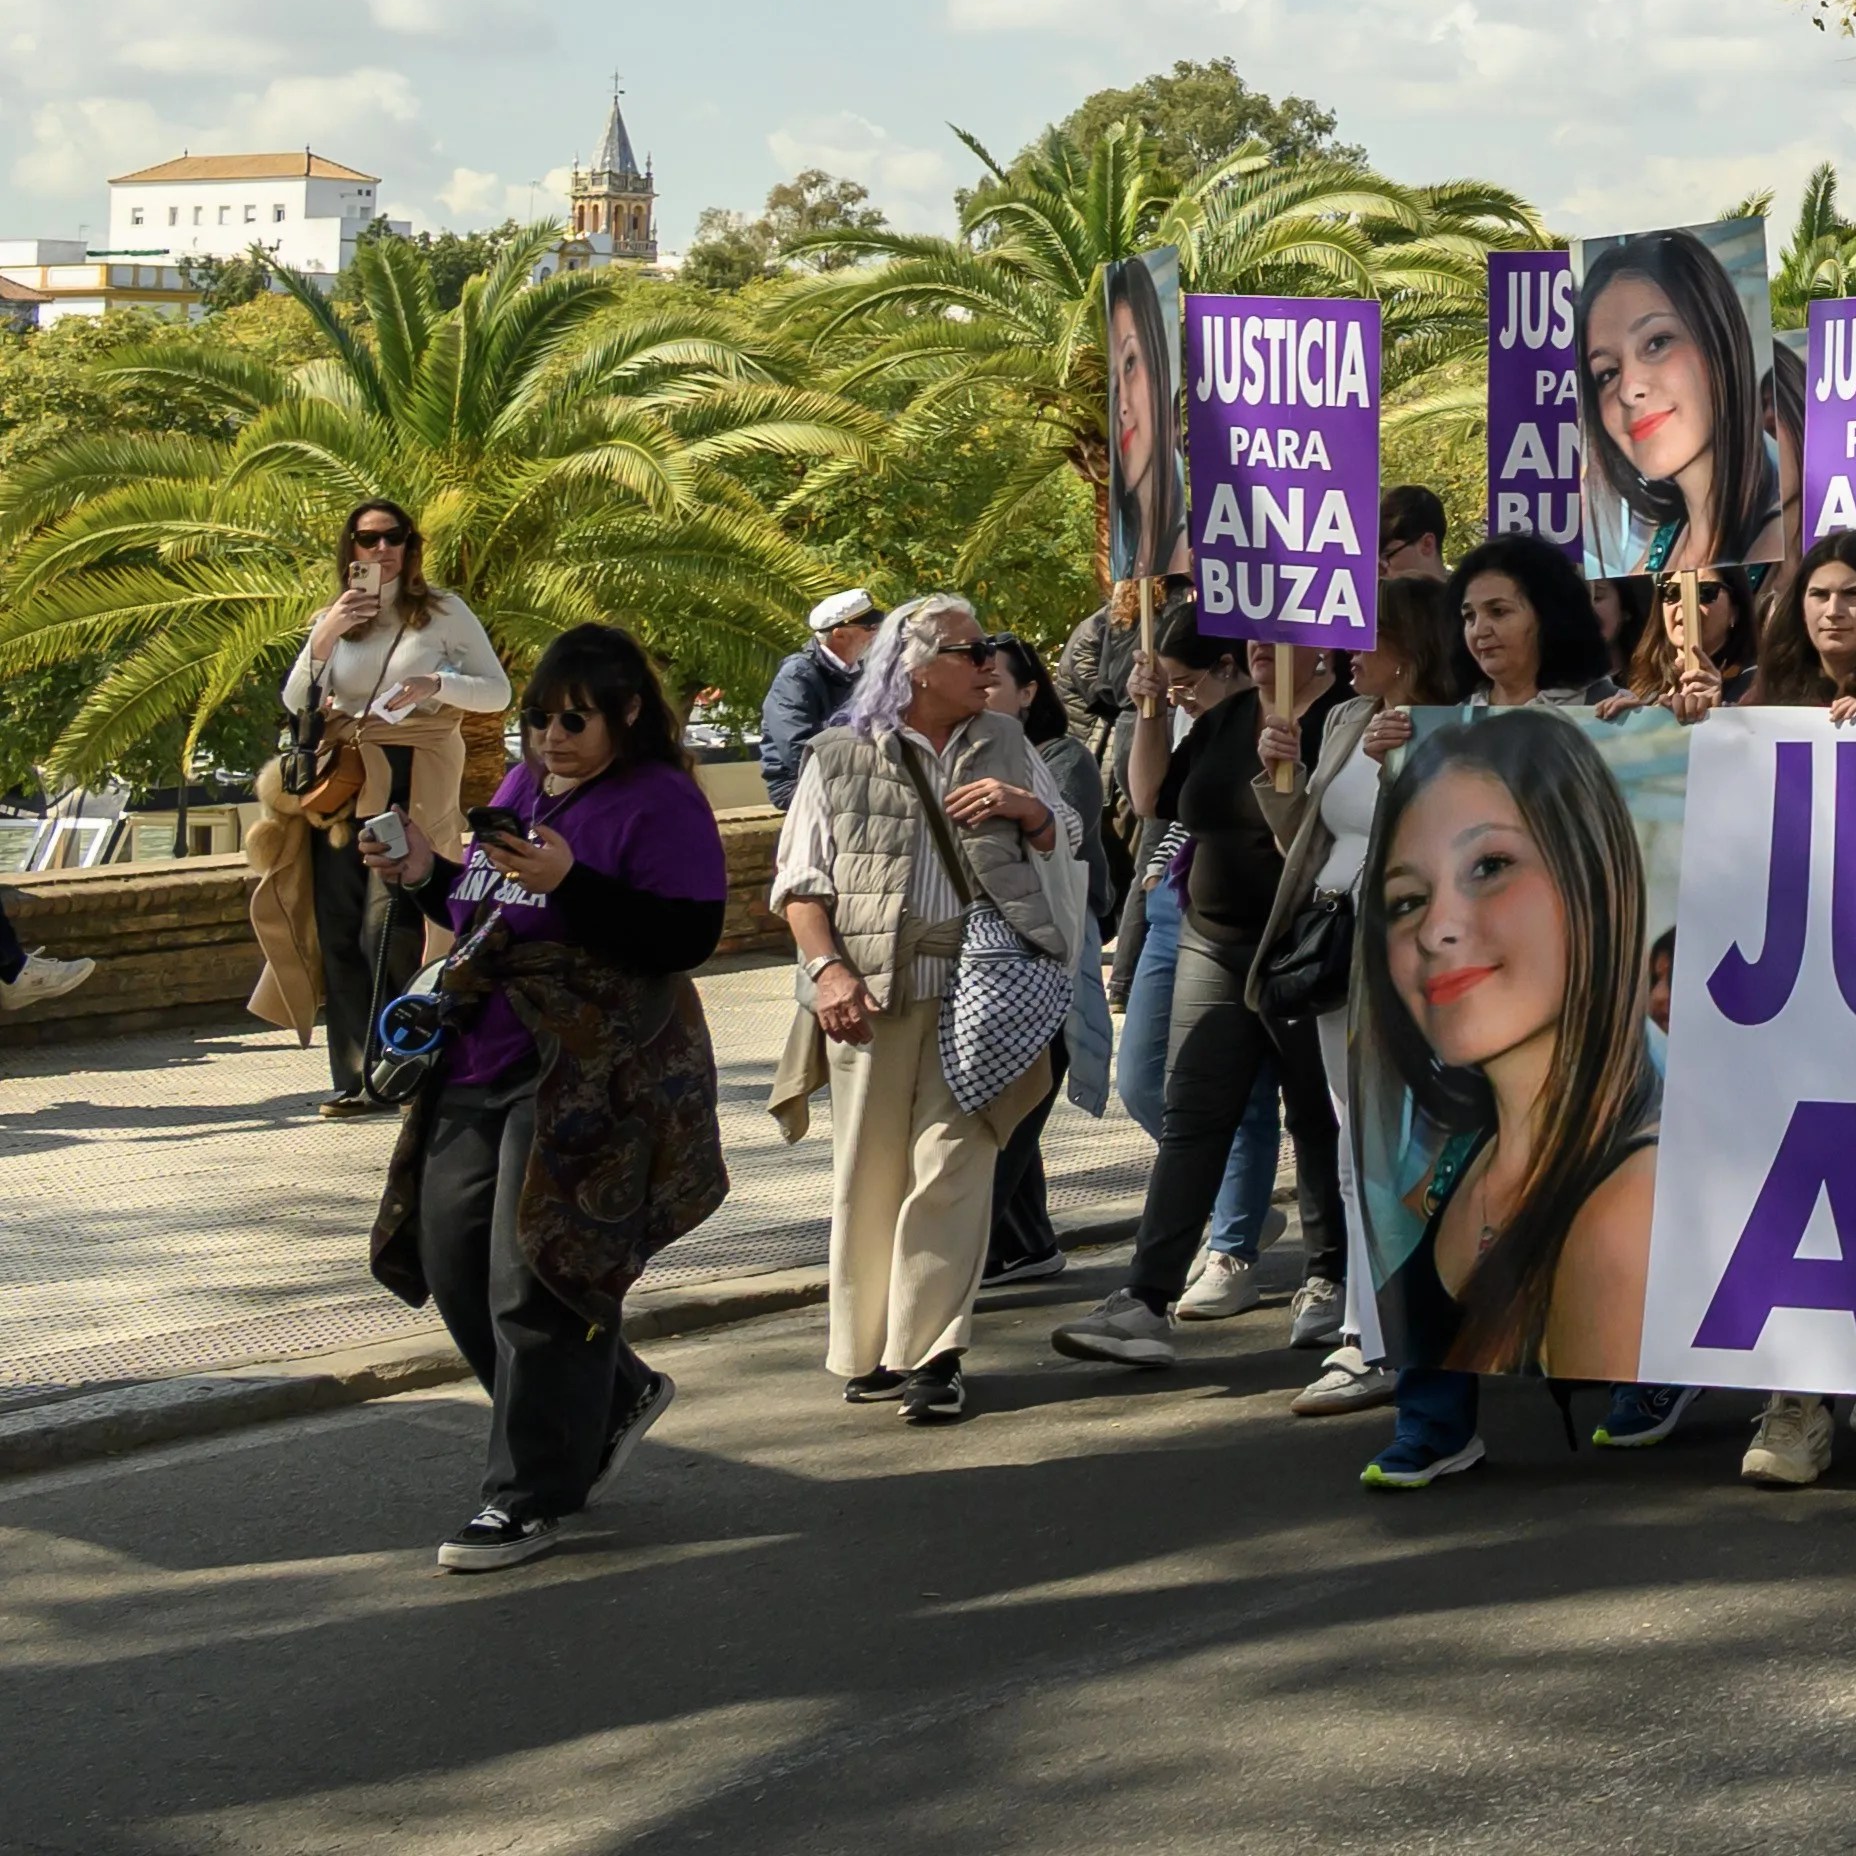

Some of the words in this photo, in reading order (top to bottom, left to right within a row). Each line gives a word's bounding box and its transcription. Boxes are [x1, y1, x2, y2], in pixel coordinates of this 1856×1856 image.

[1197, 316, 1369, 407] JUSTICIA
[1536, 370, 1578, 404] PA
[1230, 427, 1331, 471] PARA
[1203, 484, 1361, 555] ANA
[1202, 564, 1365, 627] BUZA
